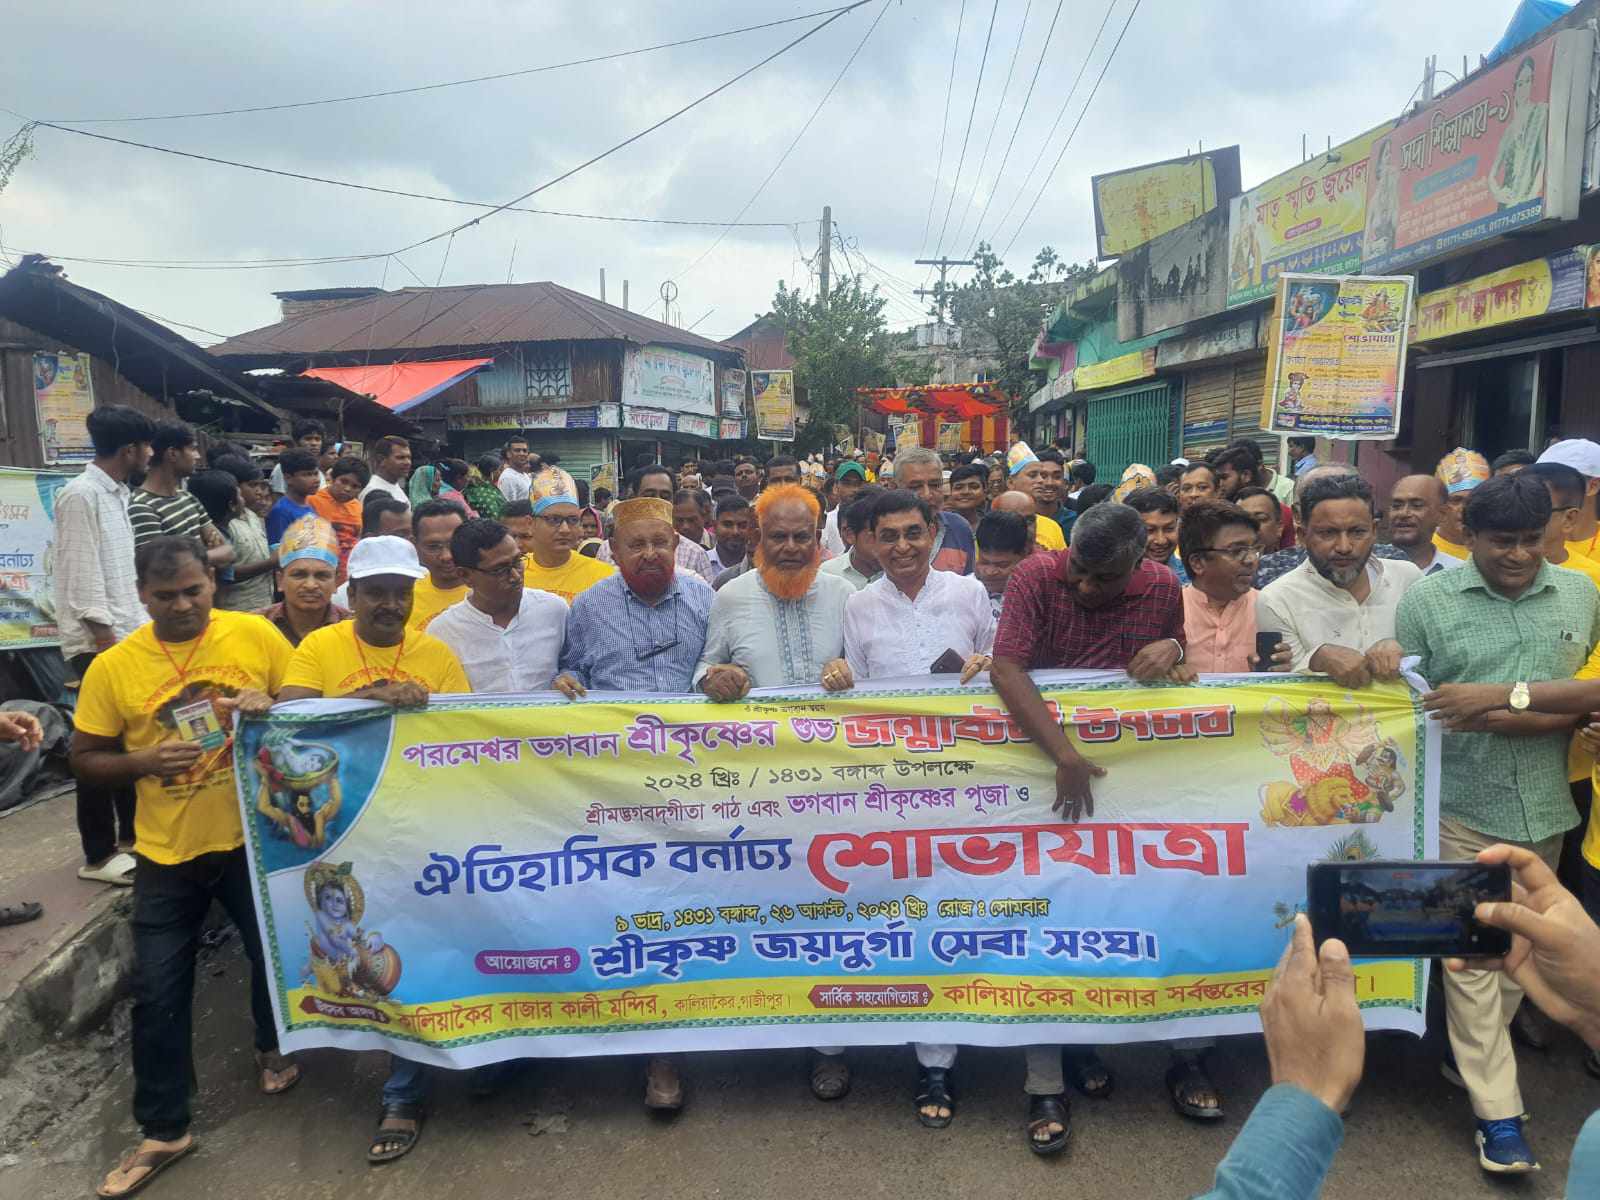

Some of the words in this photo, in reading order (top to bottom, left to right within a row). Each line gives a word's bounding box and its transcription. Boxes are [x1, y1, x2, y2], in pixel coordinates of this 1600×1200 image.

[404, 737, 521, 768] পরমেশ্বর
[528, 733, 619, 759] ভগবান
[626, 714, 778, 764] শ্রীকৃষ্ণের
[790, 717, 835, 743] শুভ
[645, 771, 702, 791] ২০২৪
[769, 767, 822, 784] ১৪৩১
[830, 764, 886, 781] বঙ্গাব্দ
[893, 758, 975, 777] উপলক্ষে
[711, 796, 741, 819] পাঠ
[748, 800, 782, 817] এবং
[787, 790, 858, 816] ভগবান
[864, 783, 956, 819] শ্রীকৃষ্ণের
[964, 783, 1010, 813] পূজা
[1016, 787, 1030, 801] ও
[414, 835, 656, 896] ঐতিহাসিক
[806, 823, 1249, 894] শোভাযাত্রা
[674, 907, 715, 927] ১৪৩১
[770, 905, 794, 922] ২৬
[857, 900, 900, 920] ২০২৪
[938, 898, 975, 918] রোজ
[990, 898, 1050, 917] সোমবার
[484, 955, 558, 972] আয়োজনে
[592, 933, 736, 977] শ্রীকৃষ্ণ
[753, 920, 913, 969] জয়দুর্গা
[931, 929, 1027, 963] সেবা
[500, 997, 552, 1021] বাজার
[561, 993, 600, 1019] কালী
[819, 986, 853, 1006] সার্বিক
[855, 986, 919, 1006] সহযোগিতায়
[941, 979, 1076, 1008] কালিয়াকৈর
[1084, 986, 1158, 1008] থানার
[1166, 978, 1266, 1003] সর্বস্তরের
